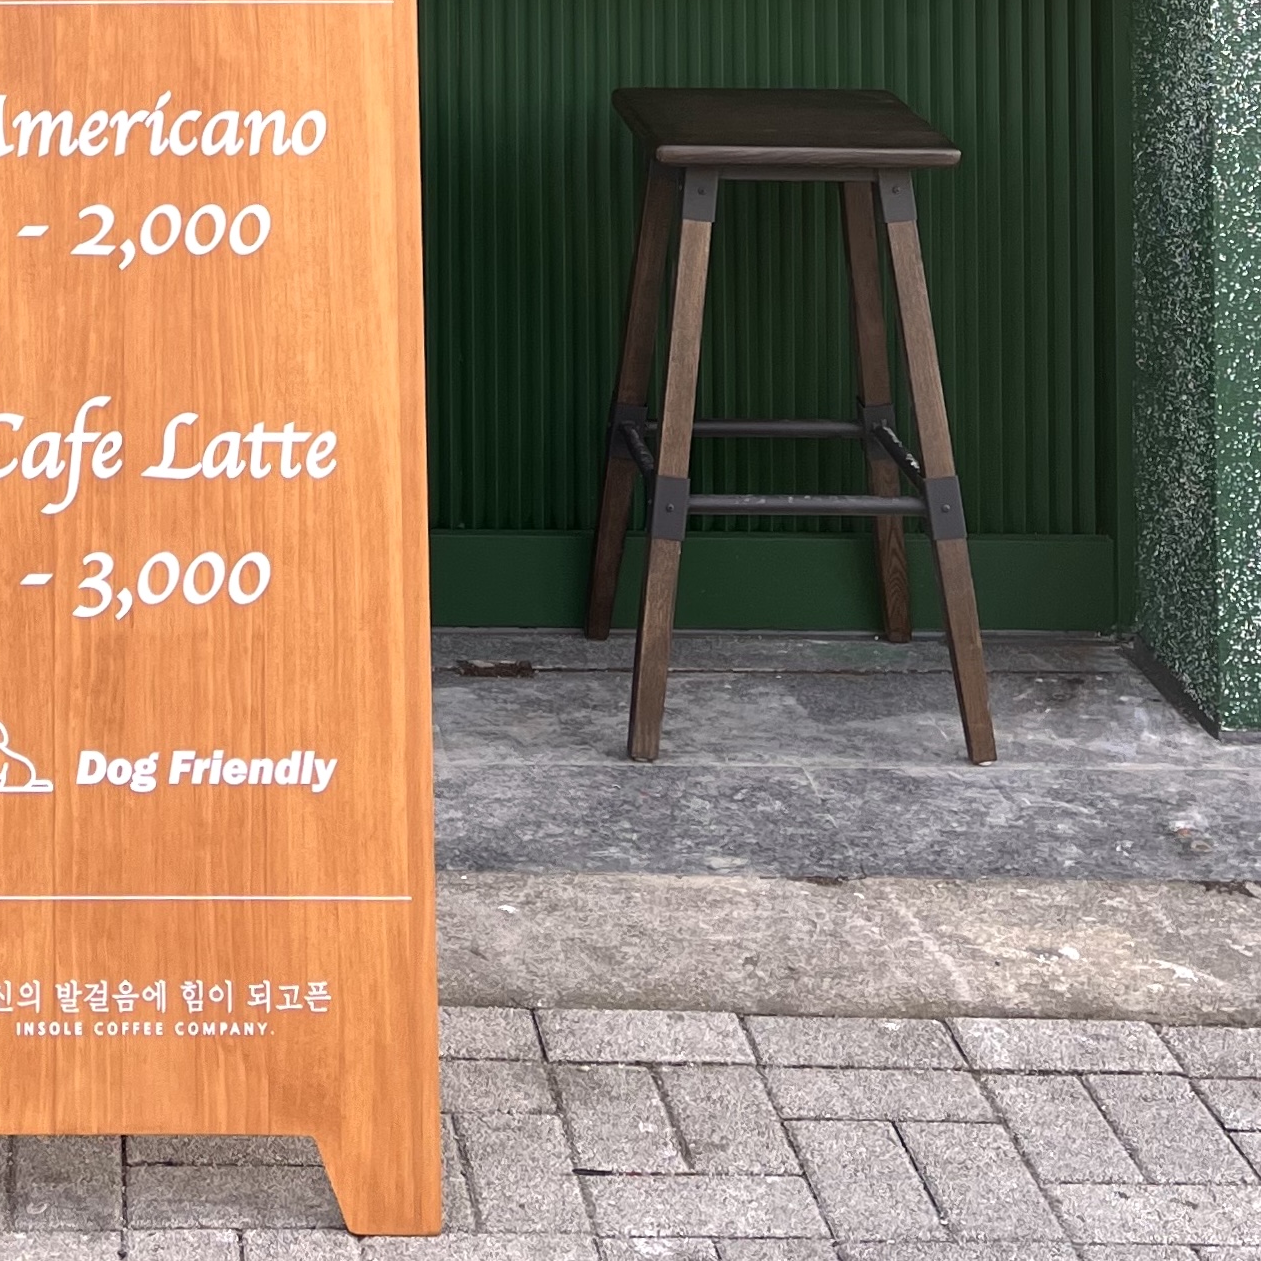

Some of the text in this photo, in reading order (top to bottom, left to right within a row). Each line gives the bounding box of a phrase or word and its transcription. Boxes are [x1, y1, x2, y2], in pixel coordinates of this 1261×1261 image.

[70, 204, 271, 270] 2,000
[141, 412, 337, 480] Latte
[72, 551, 271, 620] 3,000
[76, 750, 338, 793] Dog Friendly
[55, 979, 167, 1014] 발걸음에
[180, 979, 234, 1014] 힘이
[247, 979, 332, 1014] 되고픈
[16, 1021, 83, 1036] INSOLE
[94, 1021, 163, 1036] COFFEE
